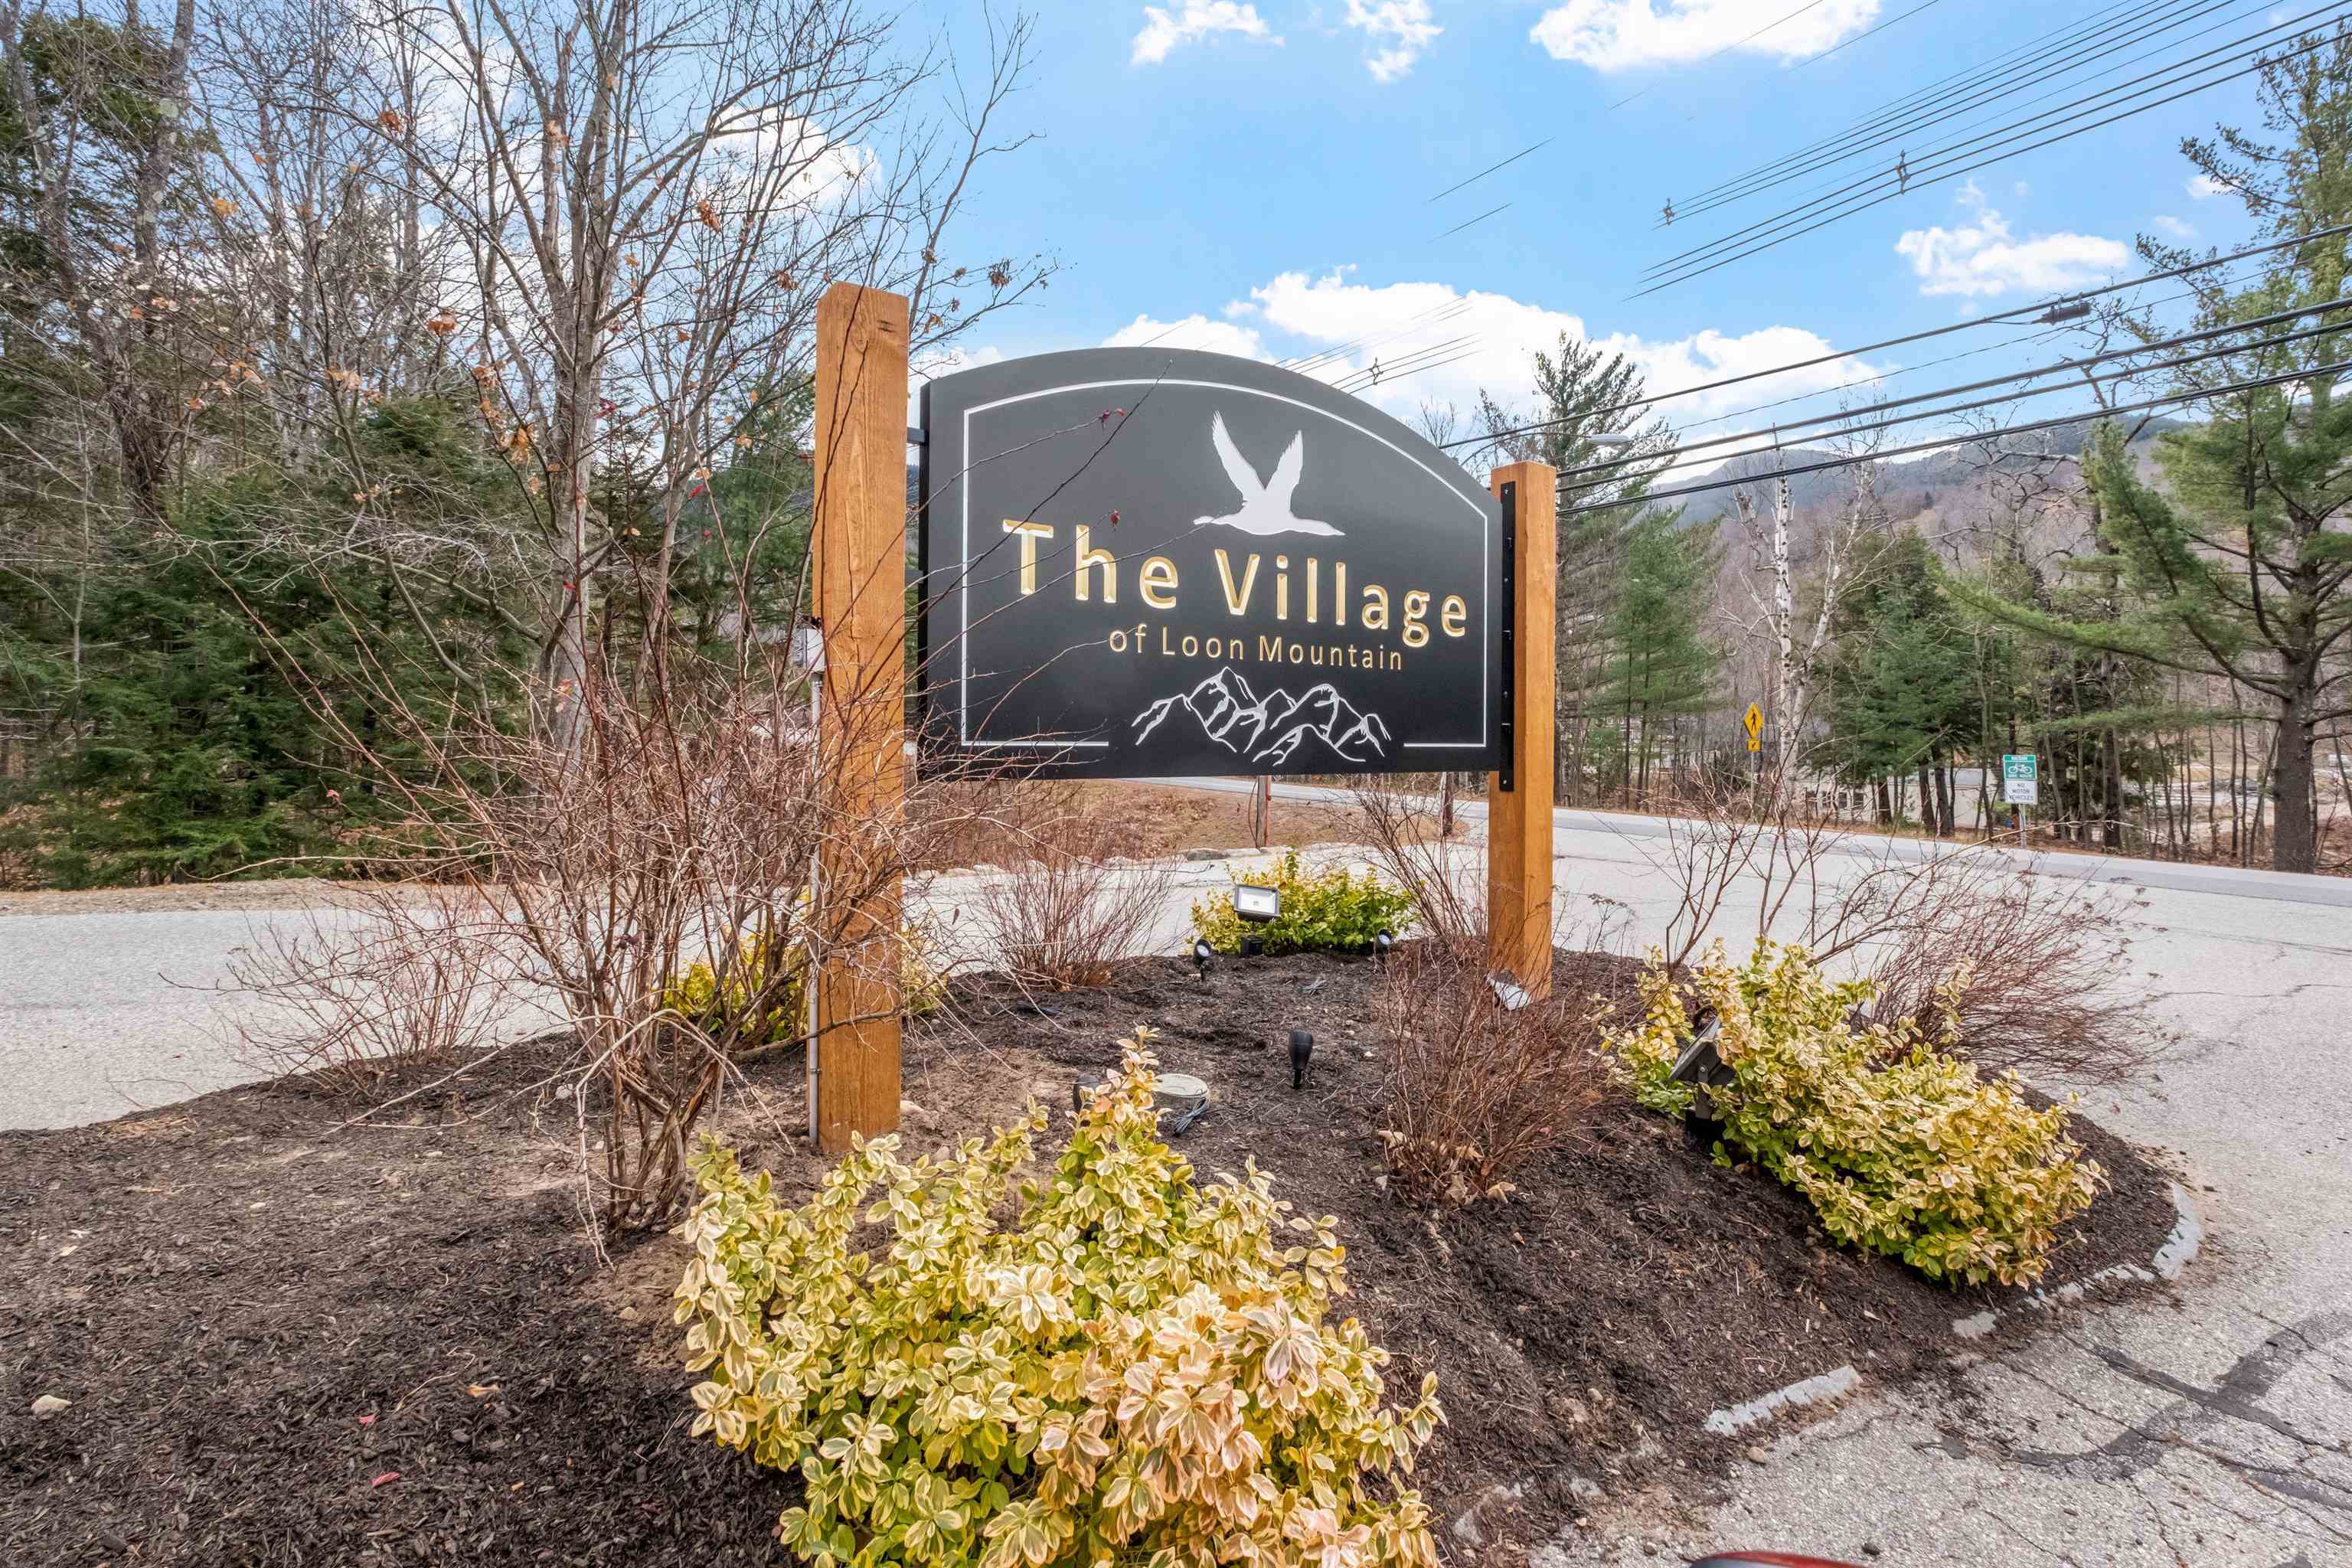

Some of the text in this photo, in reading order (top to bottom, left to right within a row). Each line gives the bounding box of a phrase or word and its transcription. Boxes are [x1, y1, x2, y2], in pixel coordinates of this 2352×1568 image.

[1002, 518, 1468, 648] The Village
[1109, 622, 1403, 671] of Loon Mountain
